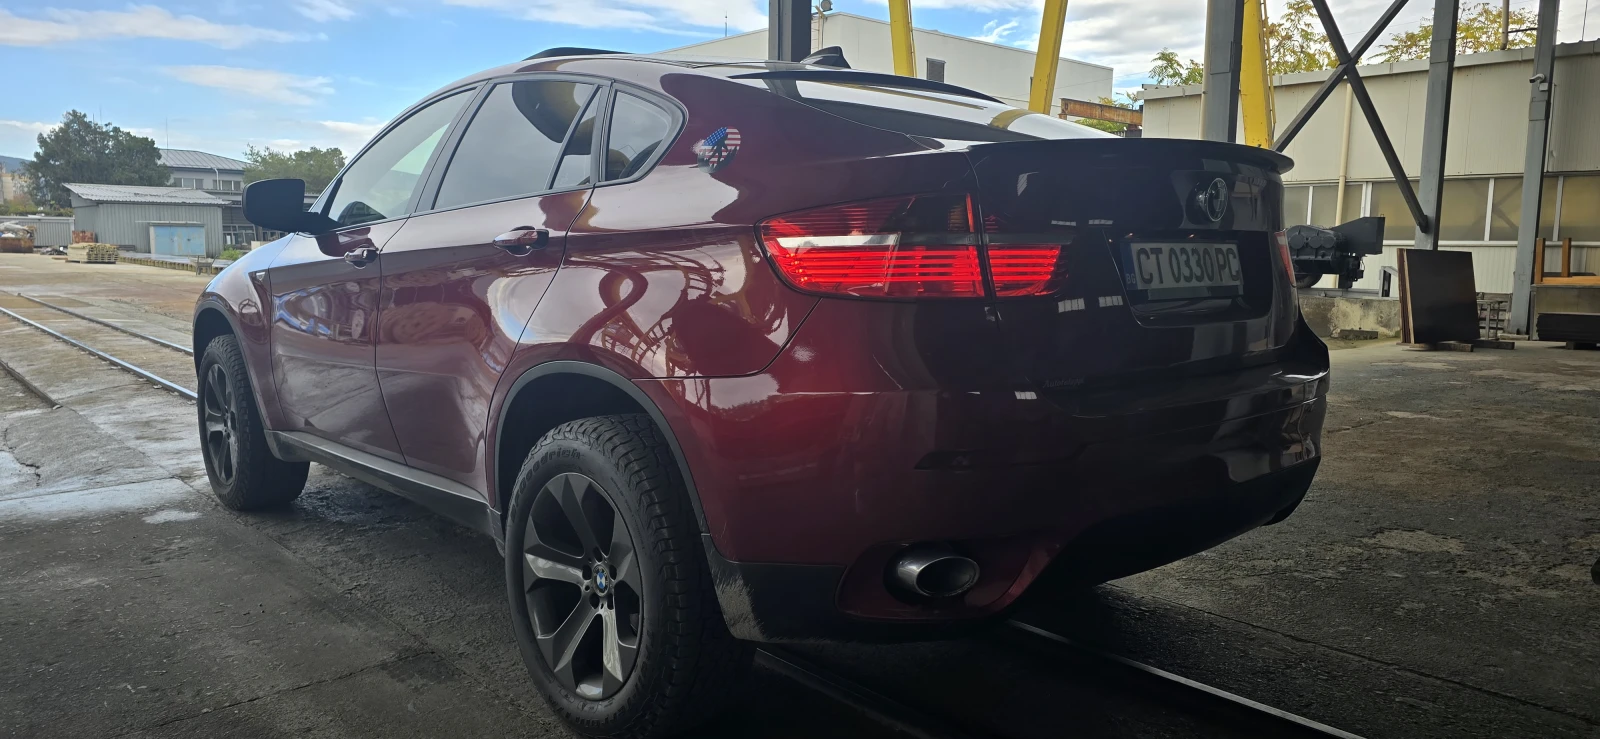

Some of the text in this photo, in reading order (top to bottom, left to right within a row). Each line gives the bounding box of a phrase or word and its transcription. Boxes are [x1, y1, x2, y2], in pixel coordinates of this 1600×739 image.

[1136, 247, 1240, 285] CT 0330 PC
[1126, 273, 1136, 285] BG
